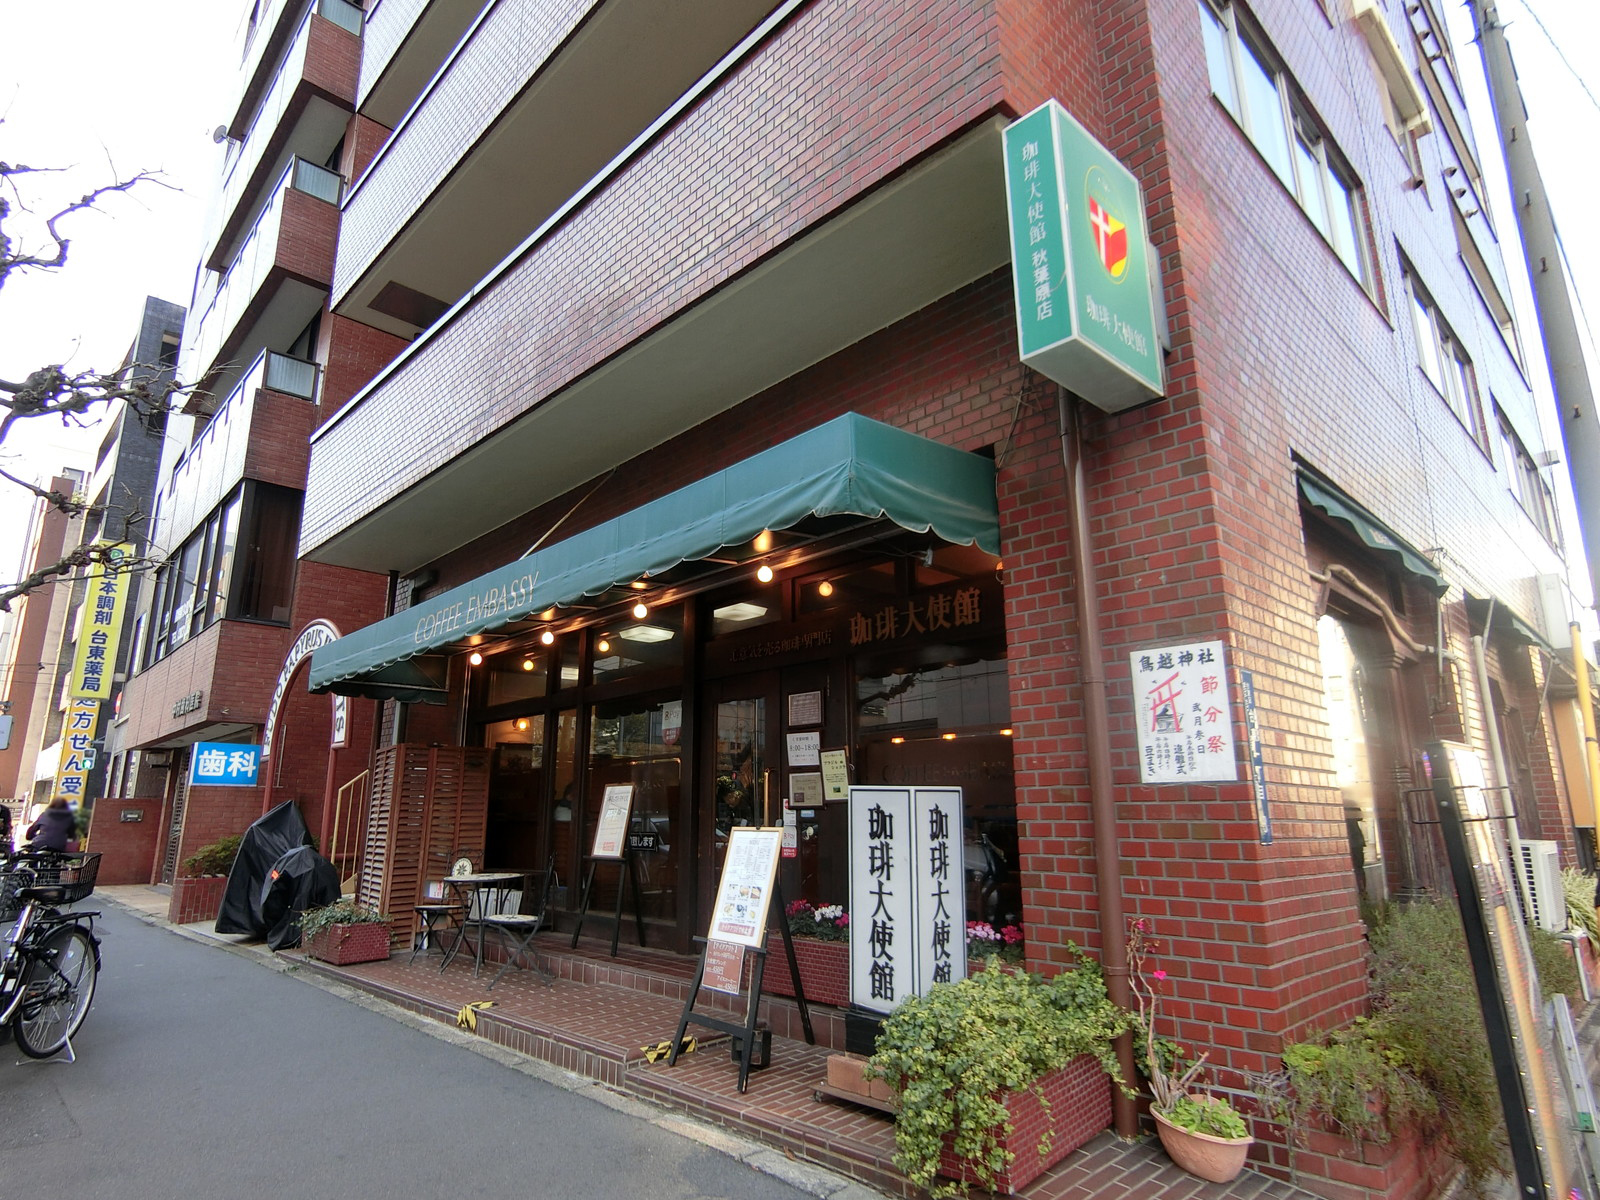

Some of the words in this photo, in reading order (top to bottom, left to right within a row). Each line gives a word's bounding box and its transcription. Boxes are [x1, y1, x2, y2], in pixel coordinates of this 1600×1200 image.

[1022, 141, 1047, 246] 珈琲大使館
[1031, 248, 1053, 322] 秋葉原店
[1086, 294, 1148, 357] 珈琲大使館
[414, 601, 463, 644] COFFEE
[465, 570, 540, 625] EMBASSY
[848, 586, 982, 648] 珈琲大使館
[80, 629, 109, 693] 台東薬局
[283, 628, 324, 682] PAPYRUS
[1138, 647, 1215, 674] 鳥越神社
[1199, 675, 1227, 754] 節分祭
[198, 749, 257, 778] 歯科
[1144, 745, 1156, 777] 豆まき
[868, 803, 895, 1002] 珈琲大使館
